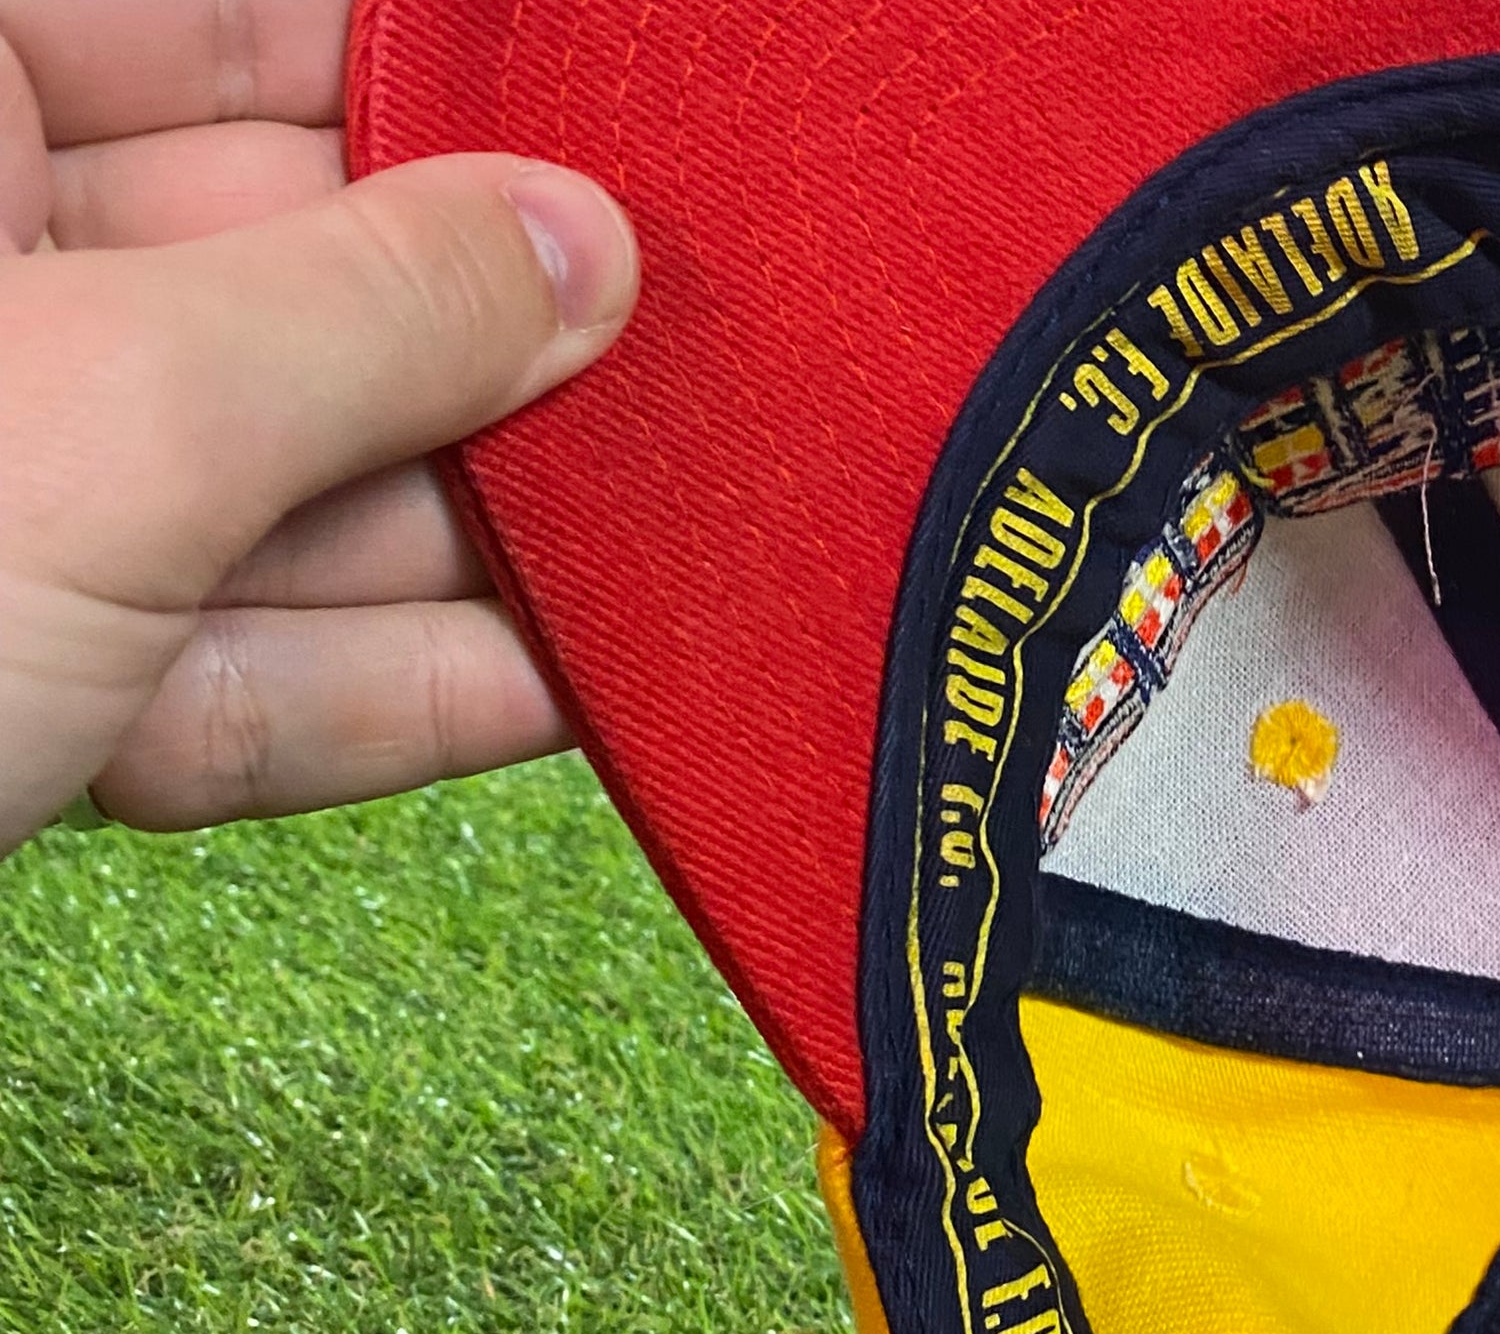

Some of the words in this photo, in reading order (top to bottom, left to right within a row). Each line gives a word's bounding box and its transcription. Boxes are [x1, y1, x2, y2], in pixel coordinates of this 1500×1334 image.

[1147, 160, 1420, 358] ADELAIDE
[1058, 327, 1170, 436] F.C.
[943, 466, 1076, 763] ADELAIDE
